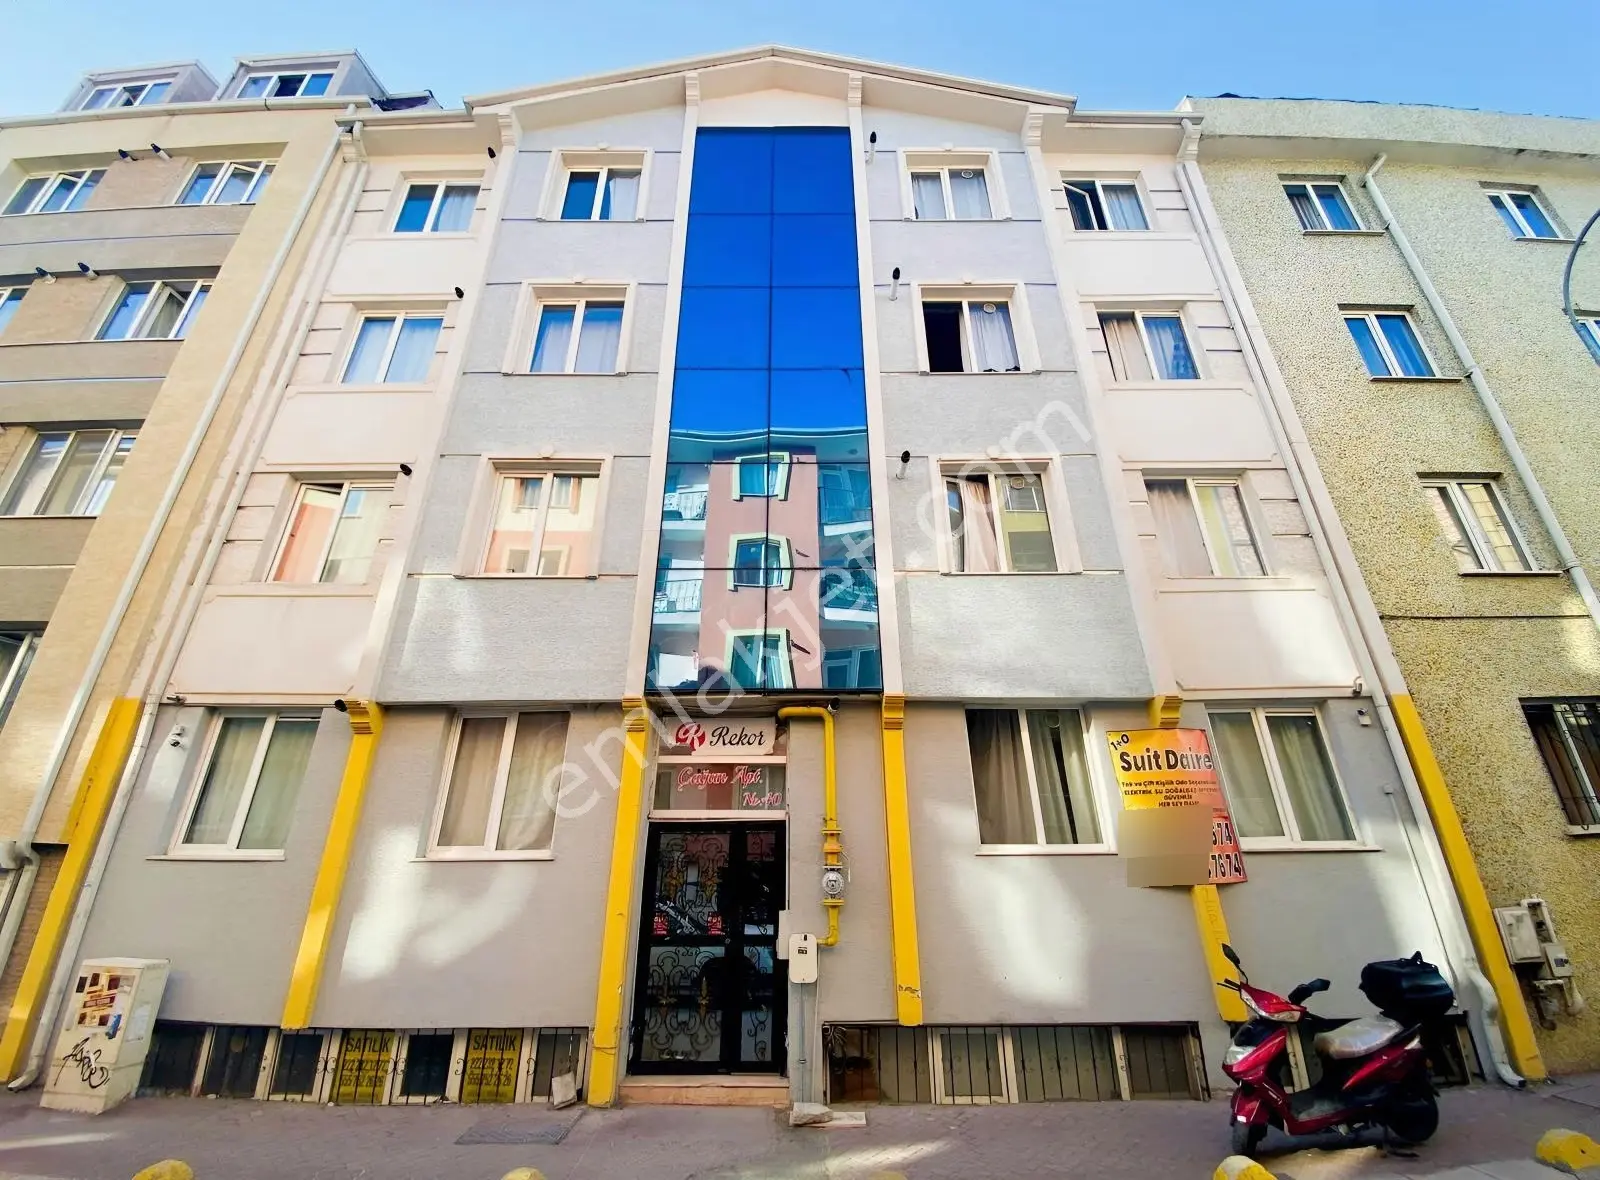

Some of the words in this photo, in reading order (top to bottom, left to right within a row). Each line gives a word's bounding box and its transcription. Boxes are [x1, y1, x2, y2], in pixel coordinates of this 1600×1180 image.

[709, 726, 766, 747] Rekor
[1119, 747, 1162, 772] Suit
[1209, 854, 1242, 879] 7674
[347, 1036, 391, 1052] SATILK
